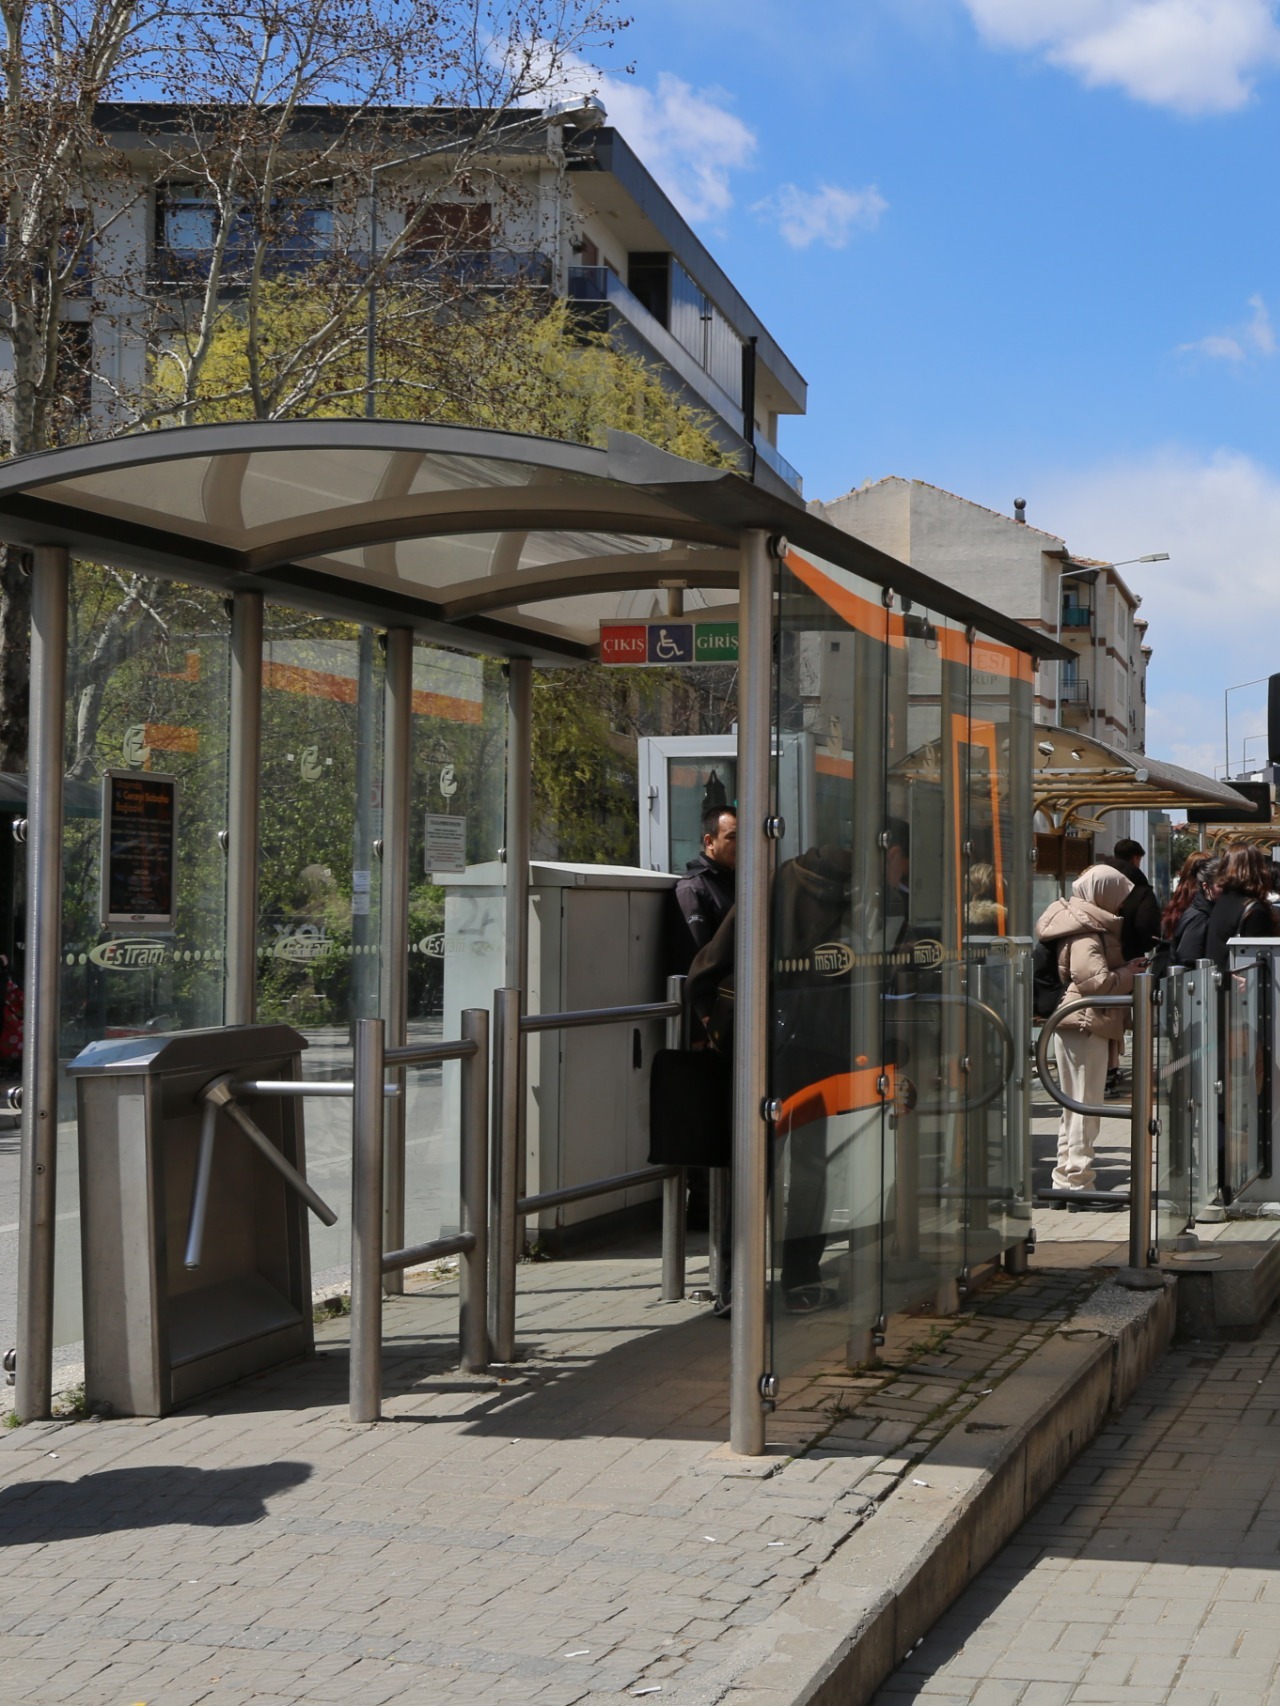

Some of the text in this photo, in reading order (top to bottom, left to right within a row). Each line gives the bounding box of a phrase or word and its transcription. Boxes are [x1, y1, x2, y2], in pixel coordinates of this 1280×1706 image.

[603, 638, 645, 653] ÇIKIŞ
[697, 633, 739, 650] GİRİŞ
[104, 943, 165, 966] EsTram
